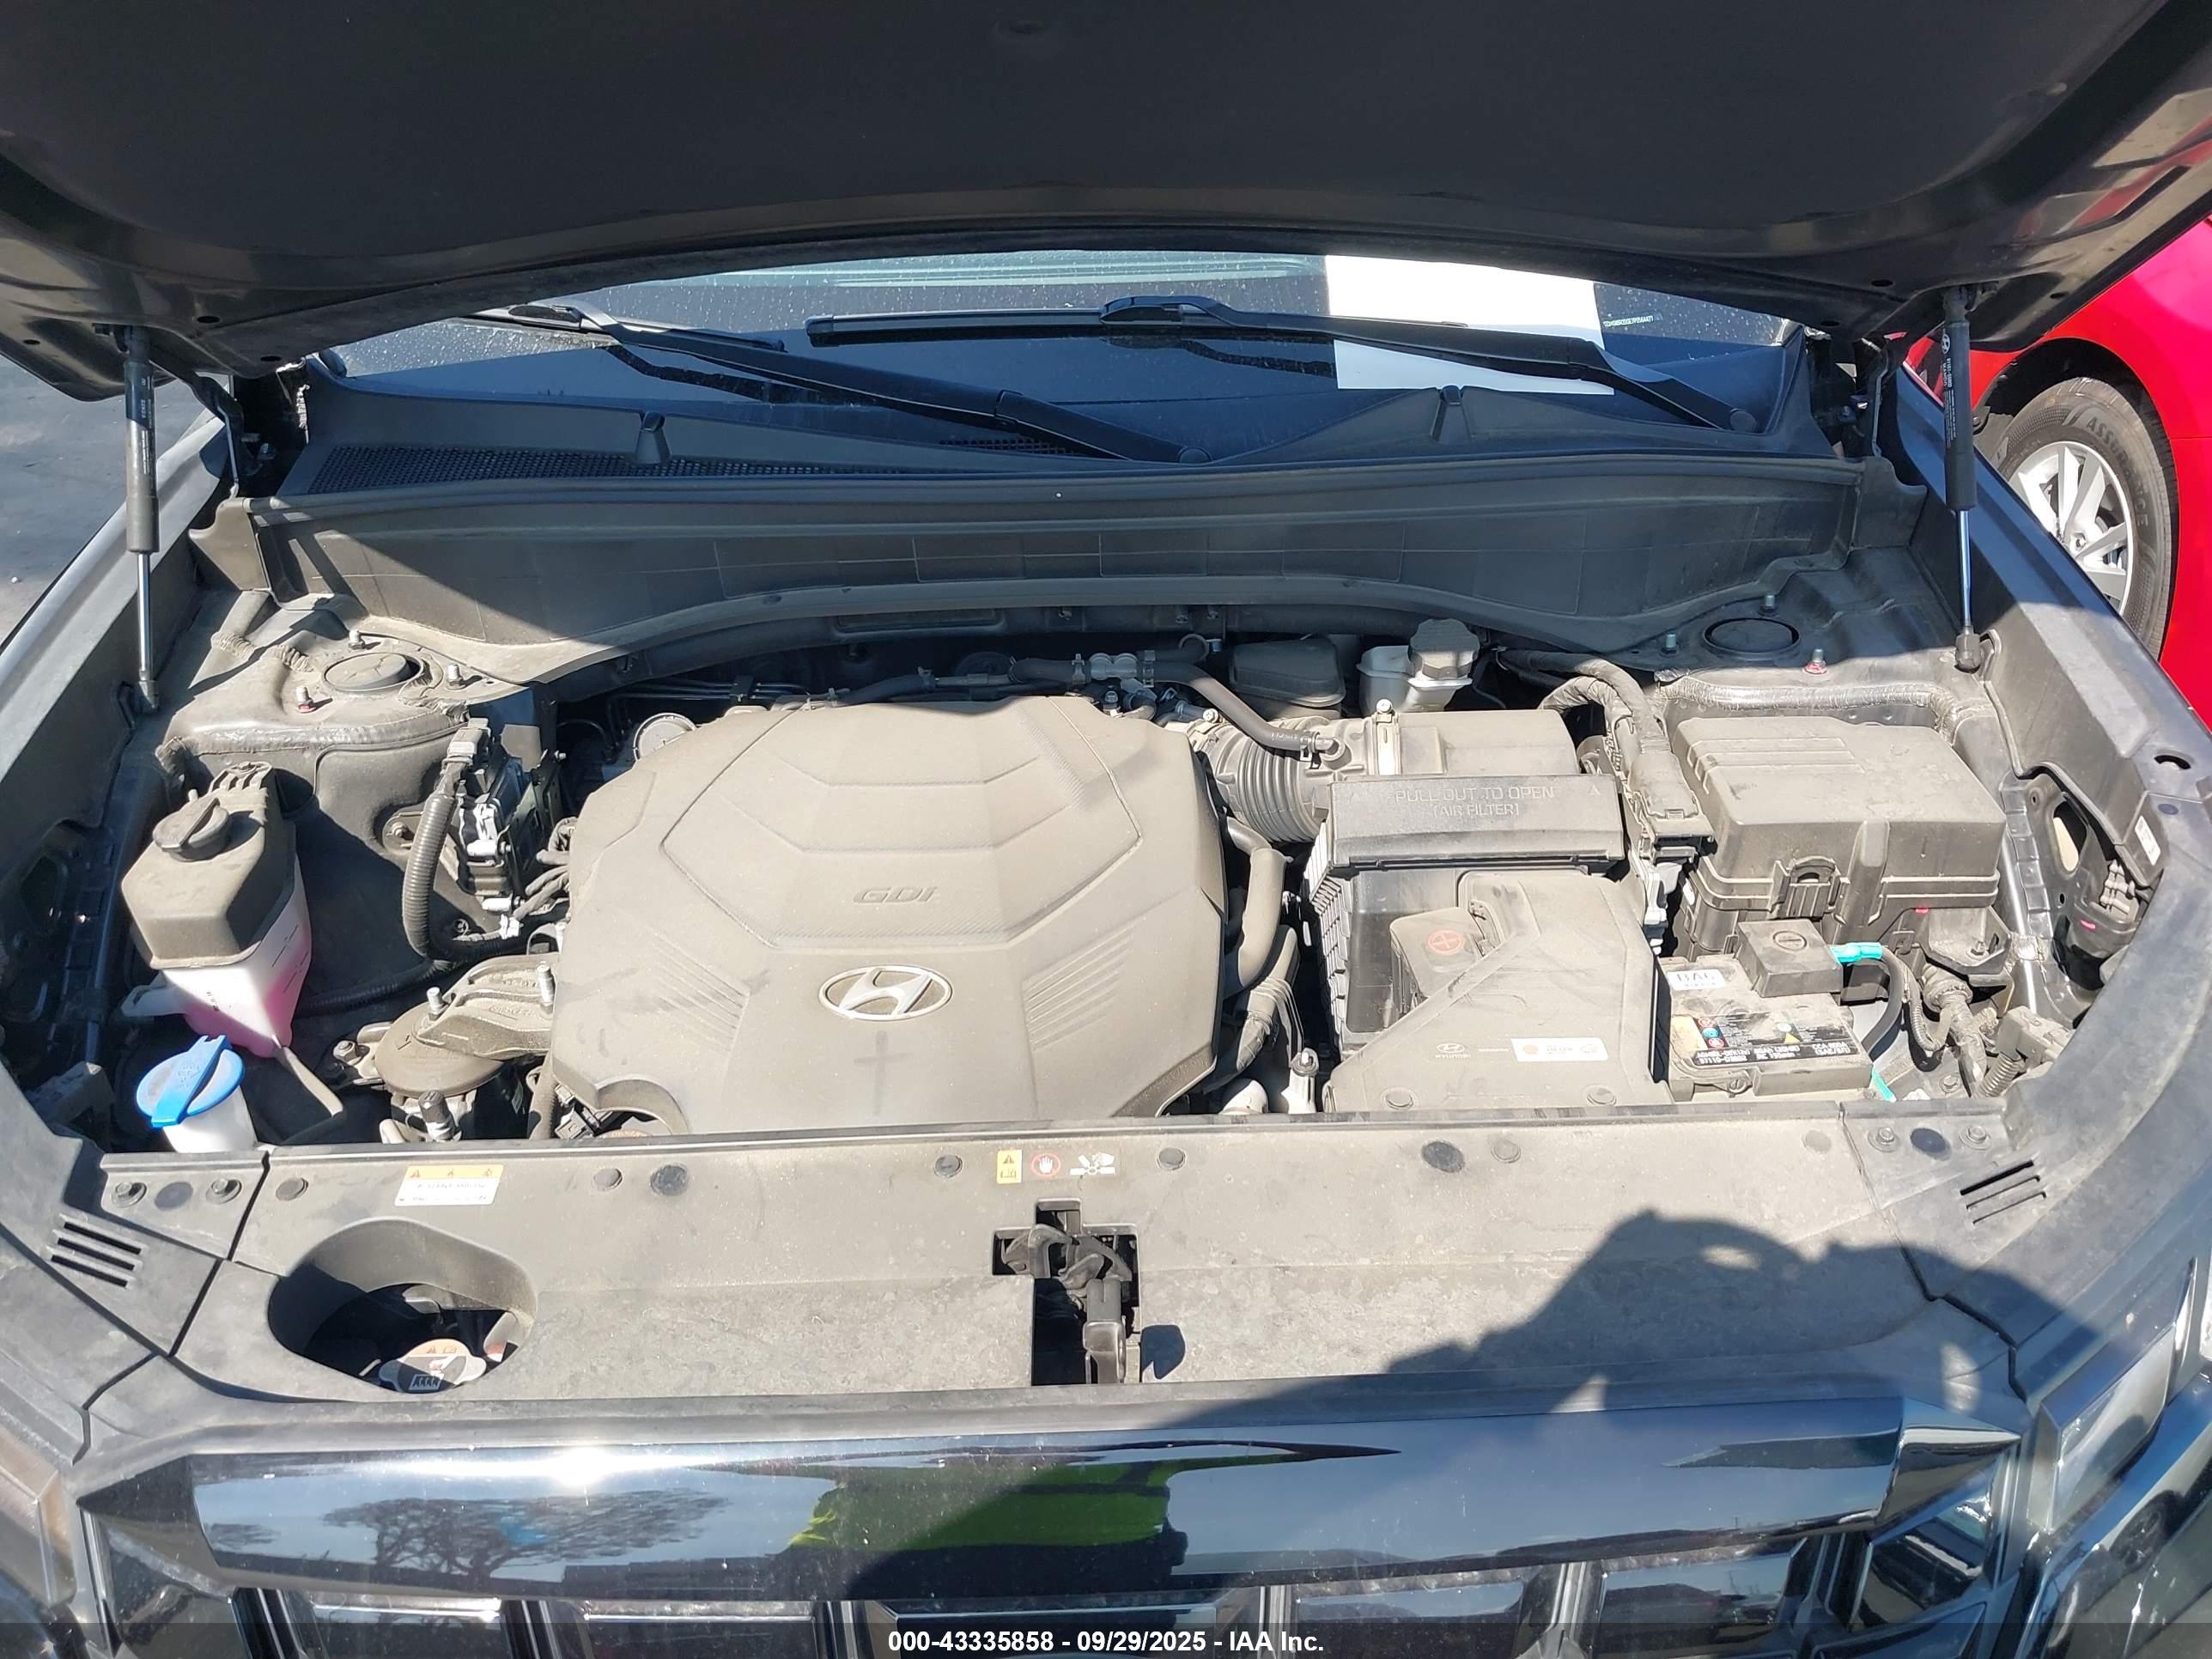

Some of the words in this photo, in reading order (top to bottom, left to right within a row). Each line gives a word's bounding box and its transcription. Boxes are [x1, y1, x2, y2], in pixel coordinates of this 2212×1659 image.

[1395, 788, 1436, 804] PULL
[1443, 787, 1477, 801] OUT
[1482, 787, 1504, 800] TO
[1508, 786, 1553, 800] OPEN
